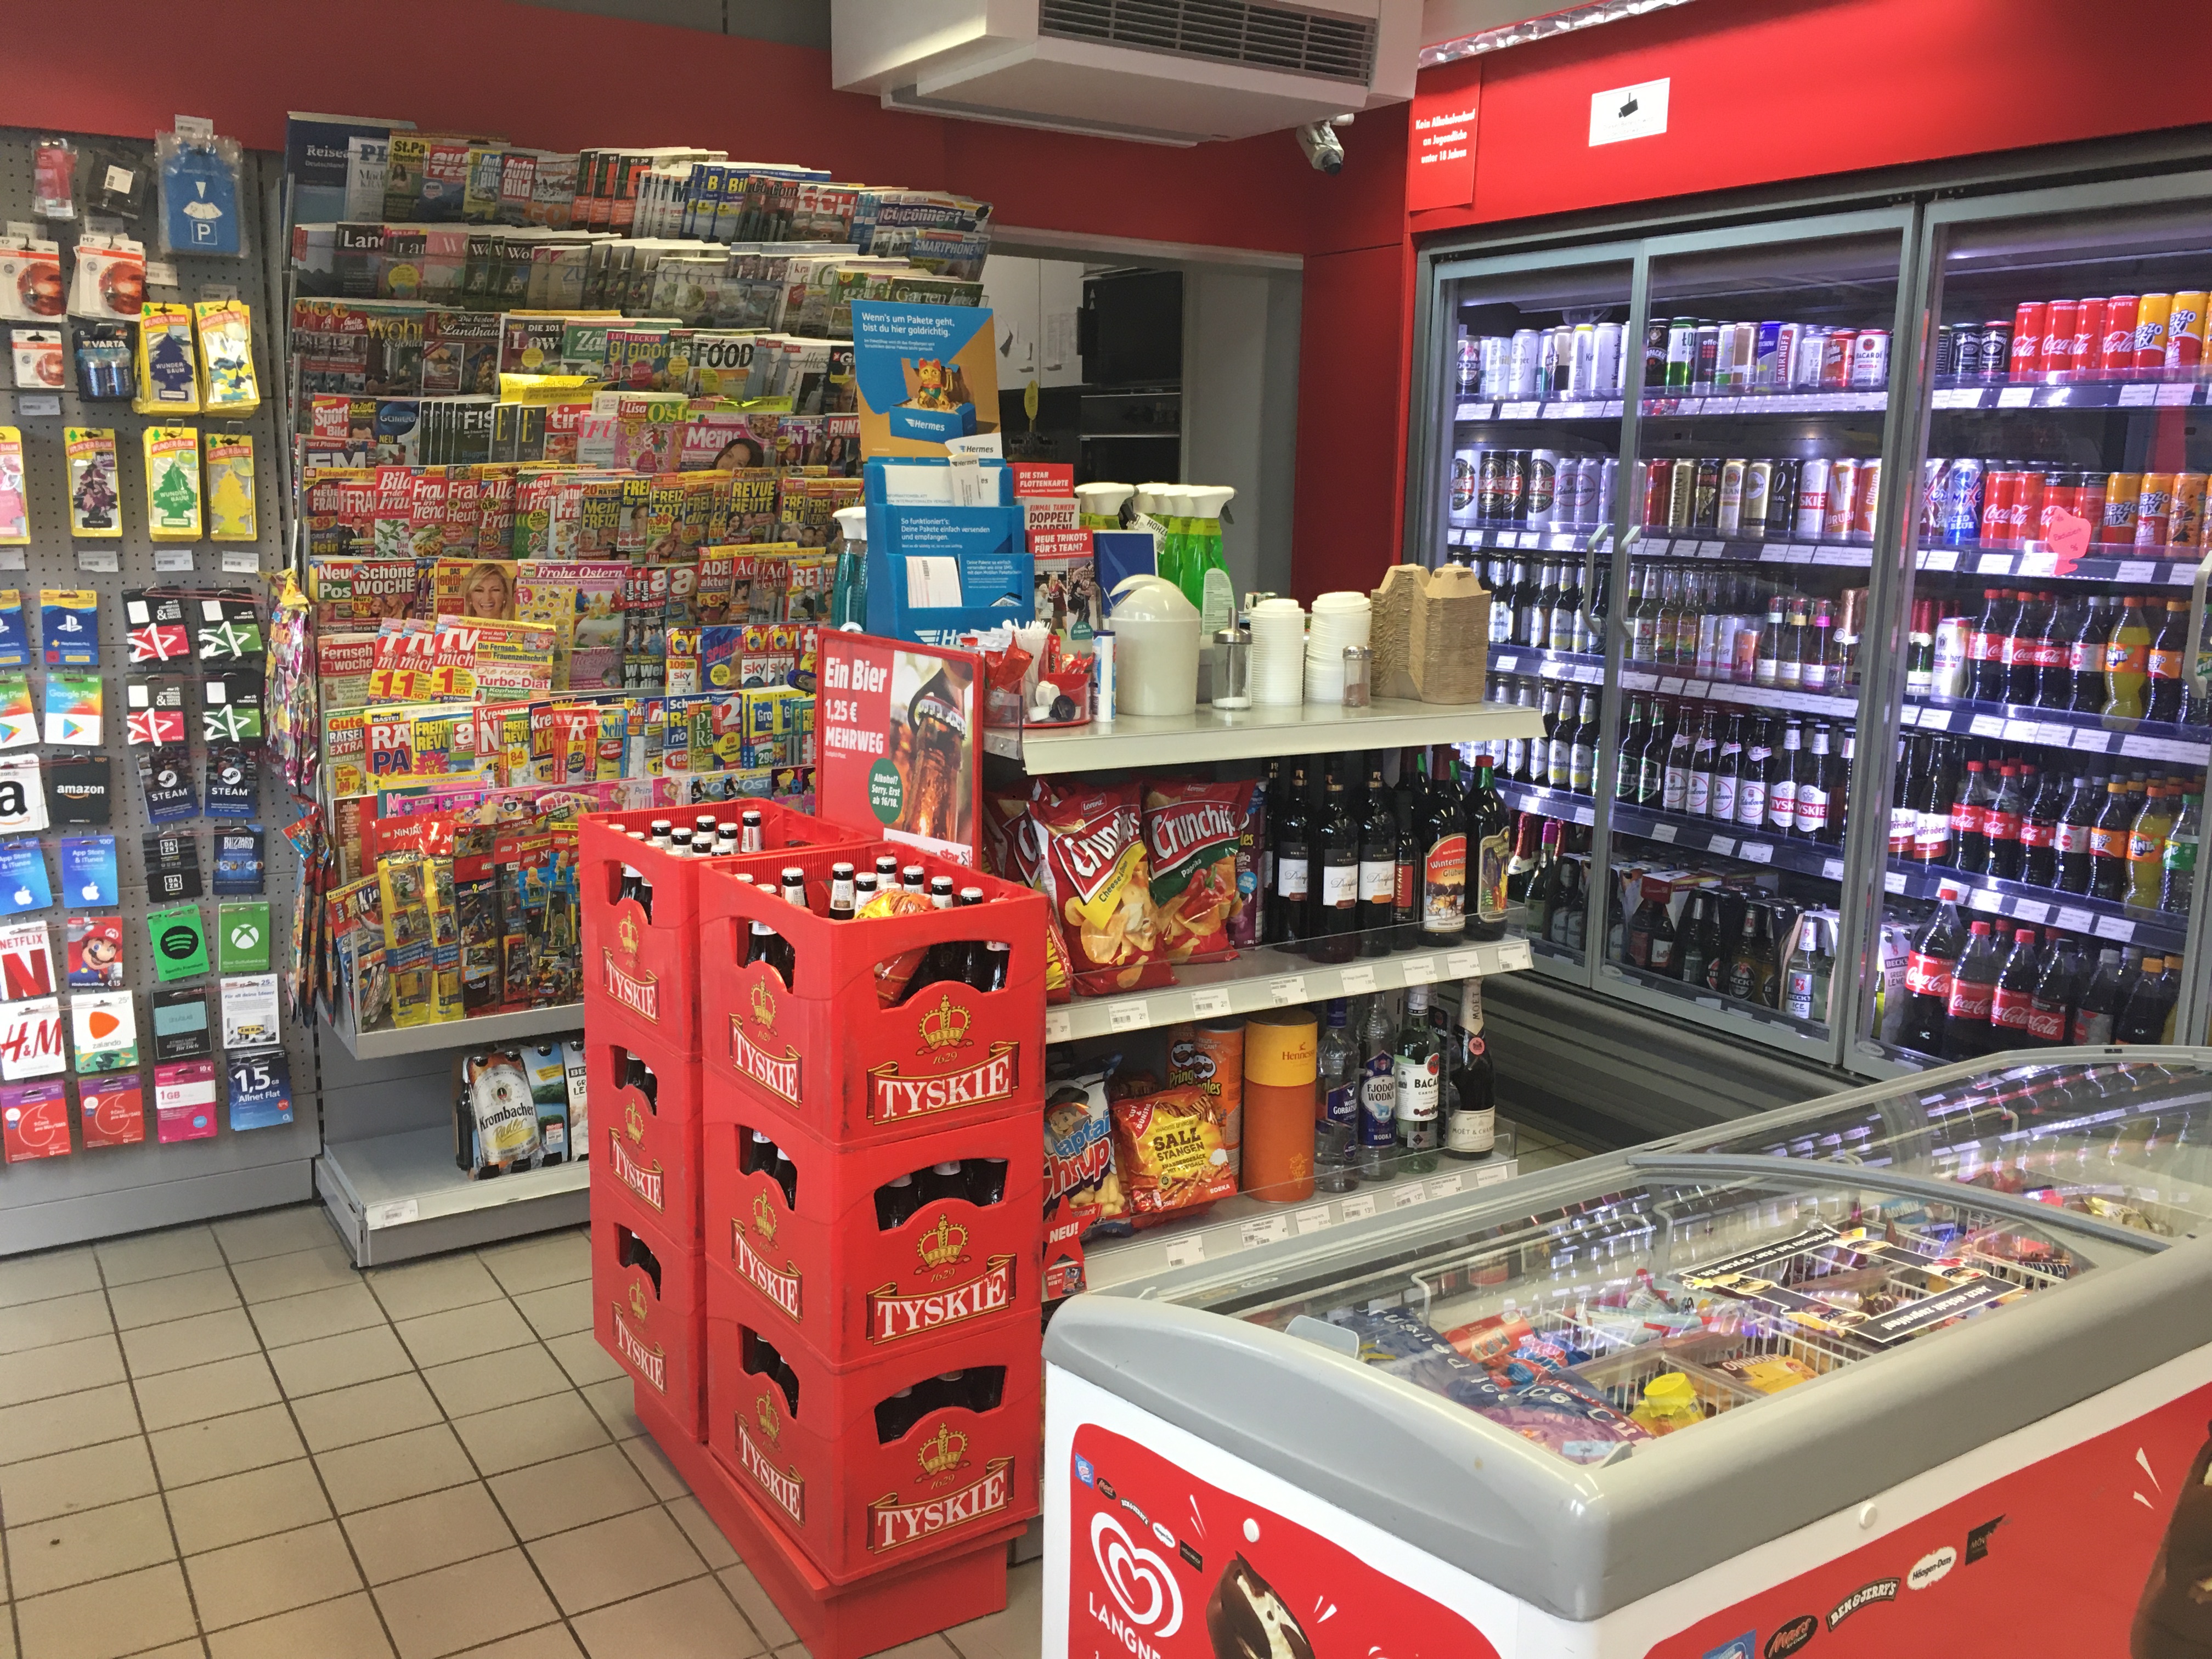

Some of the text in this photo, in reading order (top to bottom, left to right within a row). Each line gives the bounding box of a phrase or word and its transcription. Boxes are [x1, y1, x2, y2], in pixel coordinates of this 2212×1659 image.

[1415, 109, 1475, 129] Kein Alkoholverkauf
[1423, 131, 1467, 146] an Jugendliche
[1421, 149, 1466, 163] unter 18 Jahren
[504, 156, 534, 178] Auto
[504, 179, 531, 198] Bild
[198, 224, 211, 240] P
[862, 312, 890, 322] Wenn's
[907, 316, 933, 325] Pakete
[935, 318, 955, 326] geht,
[862, 323, 951, 337] bist du hier goldrichtig.
[90, 340, 126, 348] VARTA
[697, 342, 753, 368] FOOD
[1777, 334, 1790, 382] SMIRNOFF
[626, 402, 647, 414] Lisa
[314, 404, 348, 427] Sport
[327, 426, 347, 437] Bild
[914, 420, 945, 431] Hermes
[379, 435, 394, 444] NEU
[686, 427, 741, 448] Meins
[151, 439, 194, 453] WUNDER BAUM
[1032, 471, 1049, 479] STAR
[732, 480, 775, 497] REVUE
[1020, 479, 1069, 488] FLOTTENKARTE
[731, 495, 774, 512] HEUTE
[1052, 503, 1075, 511] TANKEN
[1029, 513, 1074, 523] DOPPELT
[1951, 521, 1974, 529] BLUE
[913, 533, 949, 541] empfangen.
[1035, 532, 1087, 543] NEUE TRIKOTS
[1035, 542, 1084, 552] FÜR'S TEAM?
[359, 565, 415, 579] Schöne
[579, 567, 628, 578] Ostern!
[354, 578, 415, 595] WOCHE
[443, 627, 481, 651] TV
[321, 645, 373, 658] Fernseh
[478, 642, 518, 652] Die Fernseh-
[438, 652, 475, 667] mich
[478, 651, 548, 663] UND Frauenzeitschrift
[2106, 649, 2129, 664] FANTA
[334, 657, 373, 671] woche
[744, 662, 766, 676] sky
[673, 670, 691, 681] sky
[825, 657, 887, 693] Ein Bier
[49, 690, 98, 699] Google Play
[825, 698, 857, 723] 1,25 €
[329, 717, 363, 730] Gute
[825, 726, 883, 754] MEHRWEG
[329, 741, 364, 755] EXTRA
[873, 773, 898, 785] Alkohol?
[57, 785, 104, 794] amazon
[151, 788, 188, 801] STEAM
[211, 787, 248, 796] STEAM
[872, 785, 900, 797] Sorry. Erst
[872, 797, 898, 808] ab 16/18.
[1152, 804, 1235, 860] Crunchips
[223, 836, 253, 850] BLIZZARD
[1064, 811, 1139, 878] Crunchips
[2130, 839, 2154, 853] FANTA
[940, 849, 959, 863] star
[1181, 858, 1202, 877] Paprika
[0, 934, 43, 950] NETFLIX
[183, 962, 204, 971] Premium
[606, 958, 656, 1019] TYSKIE
[240, 1026, 262, 1034] IKEA
[0, 1018, 63, 1063] H&M
[92, 1040, 121, 1049] zalando
[733, 1026, 797, 1103] TYSKIE
[933, 1052, 958, 1065] 1629
[234, 1066, 270, 1094] 1,5
[878, 1054, 1009, 1119] TYSKIE
[160, 1091, 180, 1101] 1 GB
[239, 1090, 280, 1103] Allnet Flat
[479, 1103, 534, 1132] Krombacher
[493, 1118, 527, 1143] Radler
[1452, 1127, 1470, 1135] MOËT
[1154, 1127, 1201, 1151] SALZ
[1156, 1142, 1205, 1161] STANGEN
[613, 1144, 661, 1209] TYSKIE
[1210, 1184, 1230, 1194] EDEKA
[1049, 1221, 1079, 1243] NEU!
[735, 1230, 798, 1318] TYSKIE
[878, 1267, 1006, 1338] TYSKIE
[616, 1313, 664, 1391] TYSKIE
[739, 1425, 800, 1522] TYSKIE
[879, 1470, 1005, 1548] TYSKIE
[1911, 1556, 1953, 1581] Häagen-Dazs
[1831, 1598, 1852, 1624] BEN
[1768, 1618, 1812, 1658] Mars
